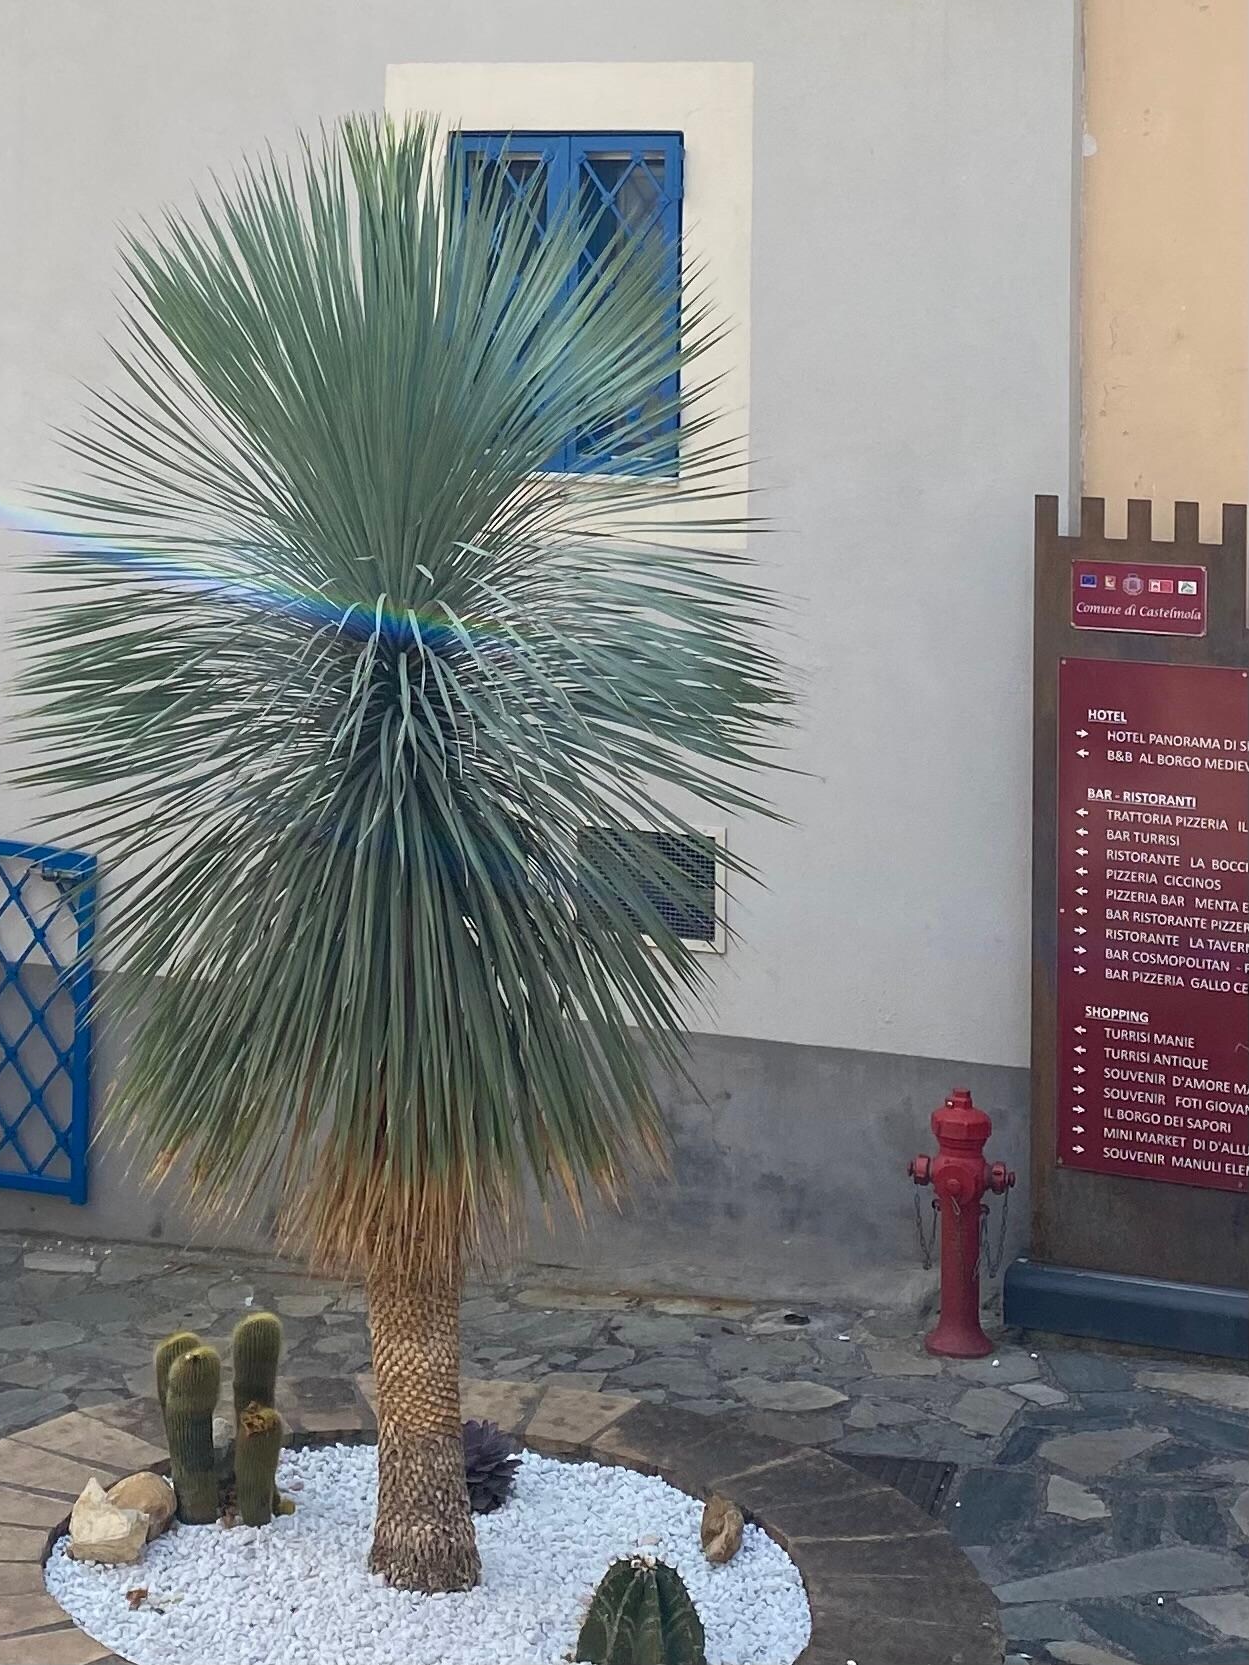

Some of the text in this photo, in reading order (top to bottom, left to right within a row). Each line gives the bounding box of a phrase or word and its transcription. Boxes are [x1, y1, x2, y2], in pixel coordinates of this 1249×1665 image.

[1076, 602, 1201, 620] Comune di Castelmola
[1088, 709, 1127, 722] HOTEL
[1107, 730, 1249, 753] HOTEL PANORAMA DI S
[1107, 750, 1133, 763] B&B
[1139, 753, 1154, 765] AL
[1157, 754, 1201, 768] BORGO
[1088, 788, 1112, 801] BAR
[1123, 791, 1196, 808] RISTORANTI
[1106, 809, 1248, 833] TRATTORIA PIZZERIA IL
[1106, 829, 1180, 846] BAR TURRISI
[1106, 849, 1180, 866] RISTORANTE
[1190, 857, 1205, 869] LA
[1106, 869, 1222, 891] PIZZERIA CICCINOS
[1106, 889, 1157, 904] PIZZERIA
[1161, 894, 1185, 907] BAR
[1195, 897, 1239, 913] MENTA
[1105, 909, 1130, 922] BAR
[1133, 911, 1207, 929] RISTORANTE
[1105, 929, 1179, 946] RISTORANTE
[1189, 937, 1204, 949] LA
[1105, 948, 1129, 961] BAR
[1132, 951, 1230, 972] COSMOPOLITAN
[1105, 968, 1249, 995] BAR PIZZERIA GALLO CE
[1085, 1005, 1149, 1023] SHOPPING
[1104, 1027, 1195, 1049] TURRISI MANIE
[1104, 1047, 1209, 1071] TURRISI ANTIQUE
[1103, 1067, 1166, 1085] SOUVENIR
[1172, 1075, 1230, 1093] D'AMORE
[1103, 1087, 1166, 1105] SOUVENIR
[1175, 1096, 1202, 1110] FOTI
[1104, 1107, 1231, 1133] IL BORGO DEI SAPORI
[1104, 1127, 1133, 1141] MINI
[1136, 1131, 1187, 1148] MARKET
[1193, 1138, 1205, 1151] DI
[1103, 1147, 1165, 1165] SOUVENIR
[1171, 1156, 1221, 1173] MANULI
